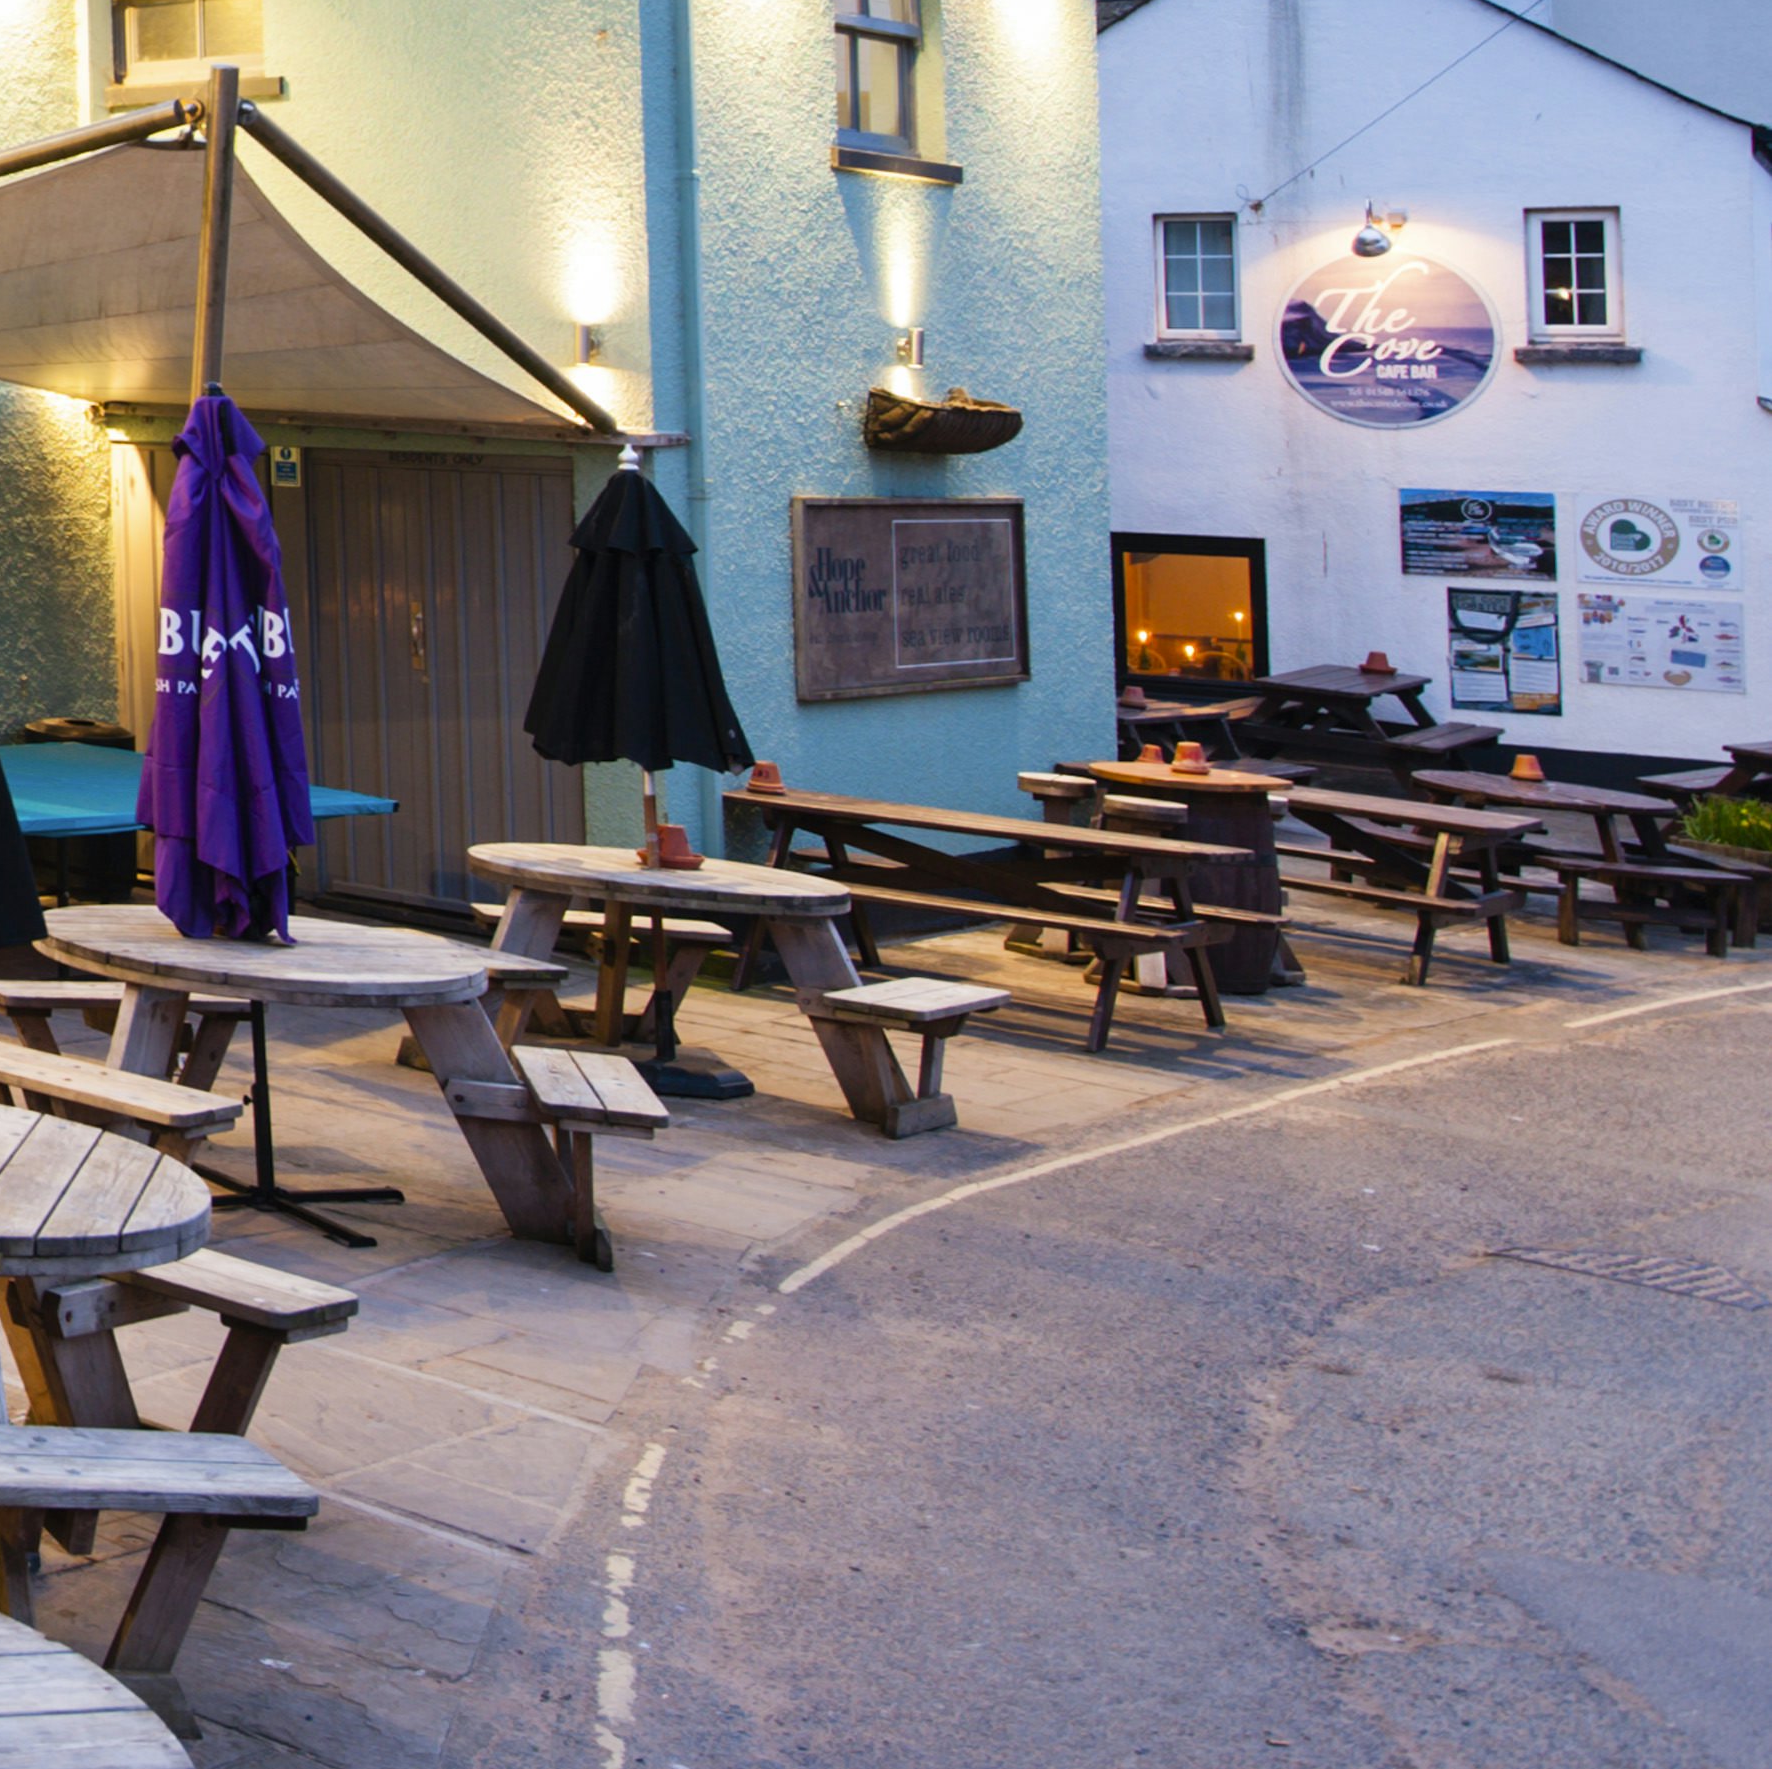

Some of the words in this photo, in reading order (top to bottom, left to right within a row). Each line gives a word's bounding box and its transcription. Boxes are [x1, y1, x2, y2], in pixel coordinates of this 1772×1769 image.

[1313, 261, 1430, 334] The
[1319, 332, 1443, 378] Cove
[1376, 364, 1409, 379] CAFE
[1410, 364, 1438, 379] BAR
[1583, 500, 1627, 536] AWARD
[1627, 500, 1677, 538] WINNER
[817, 546, 866, 592] Hope
[900, 543, 941, 571] great
[946, 540, 980, 563] food
[1593, 551, 1665, 574] 2016/2017
[819, 579, 888, 614] Anchor
[900, 583, 931, 607] real
[934, 582, 967, 605] ales
[901, 629, 927, 648] sea
[928, 625, 963, 645] view
[967, 623, 1010, 644] rooms
